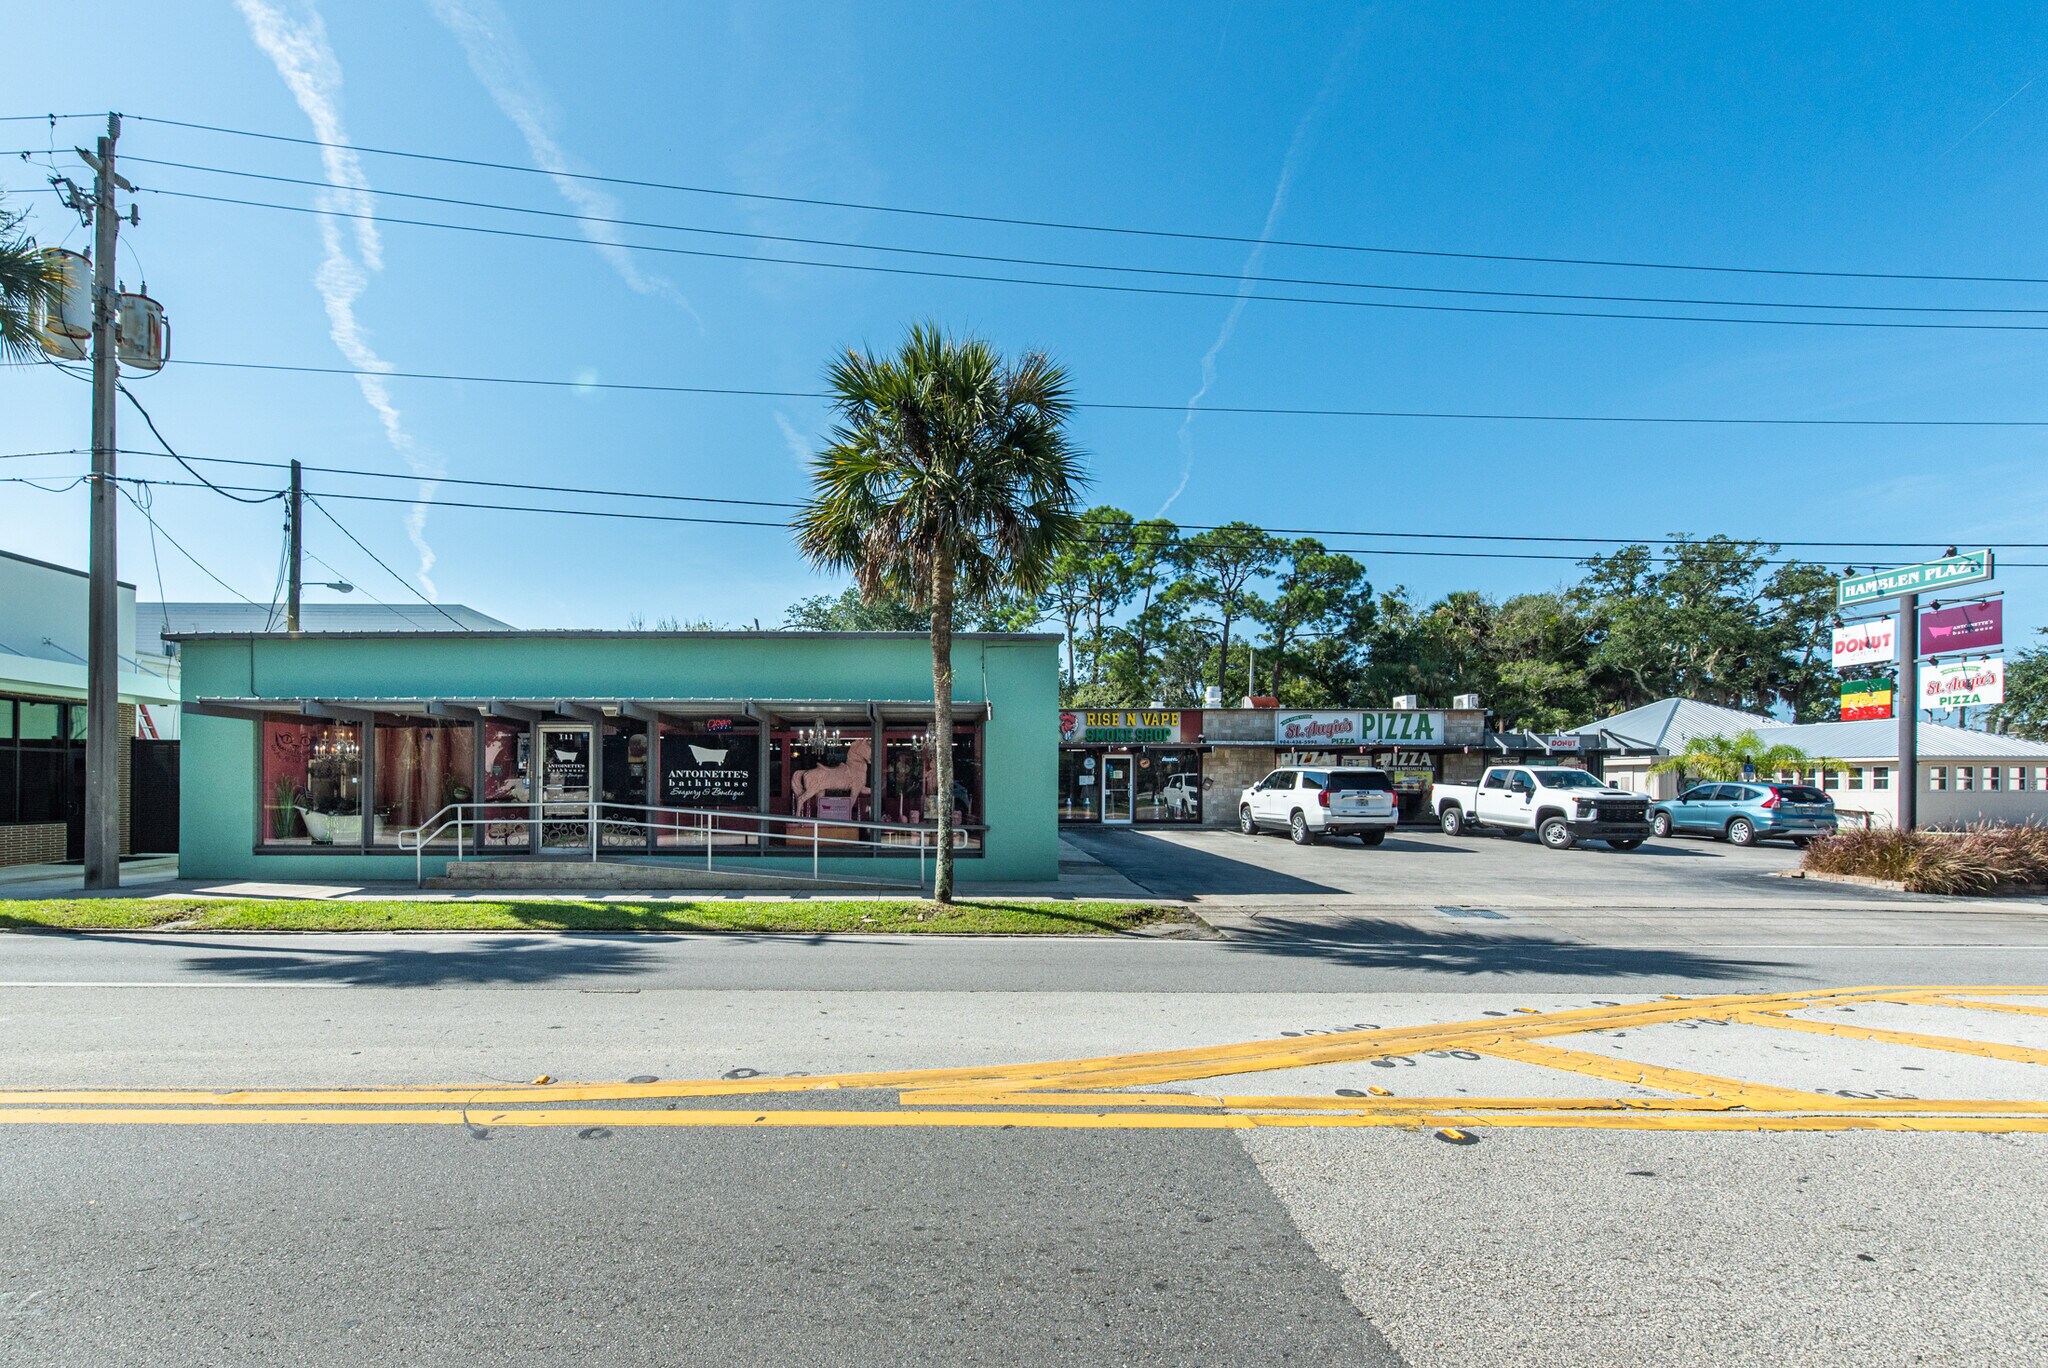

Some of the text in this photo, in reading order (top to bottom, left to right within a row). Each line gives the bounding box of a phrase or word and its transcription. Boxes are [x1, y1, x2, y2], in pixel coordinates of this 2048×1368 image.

[1845, 571, 1920, 597] HAMBLEN
[1953, 620, 1993, 630] ANTONETTE'S
[1835, 633, 1891, 654] DONUT
[1926, 681, 1946, 696] St.
[1939, 694, 1981, 706] PIZZA
[1086, 712, 1180, 727] RISE N VAPE
[1362, 713, 1435, 740] PIZZA
[1085, 728, 1171, 742] SMOKE SHOP
[1285, 723, 1305, 739] St.
[1304, 718, 1354, 739] Augie's
[1280, 752, 1331, 766] PIZZA
[1380, 752, 1432, 766] PIZZA
[669, 769, 749, 779] ANTOINETTE'S
[668, 779, 748, 787] bathhouse
[701, 788, 711, 796] &
[711, 787, 745, 800] Boutique
